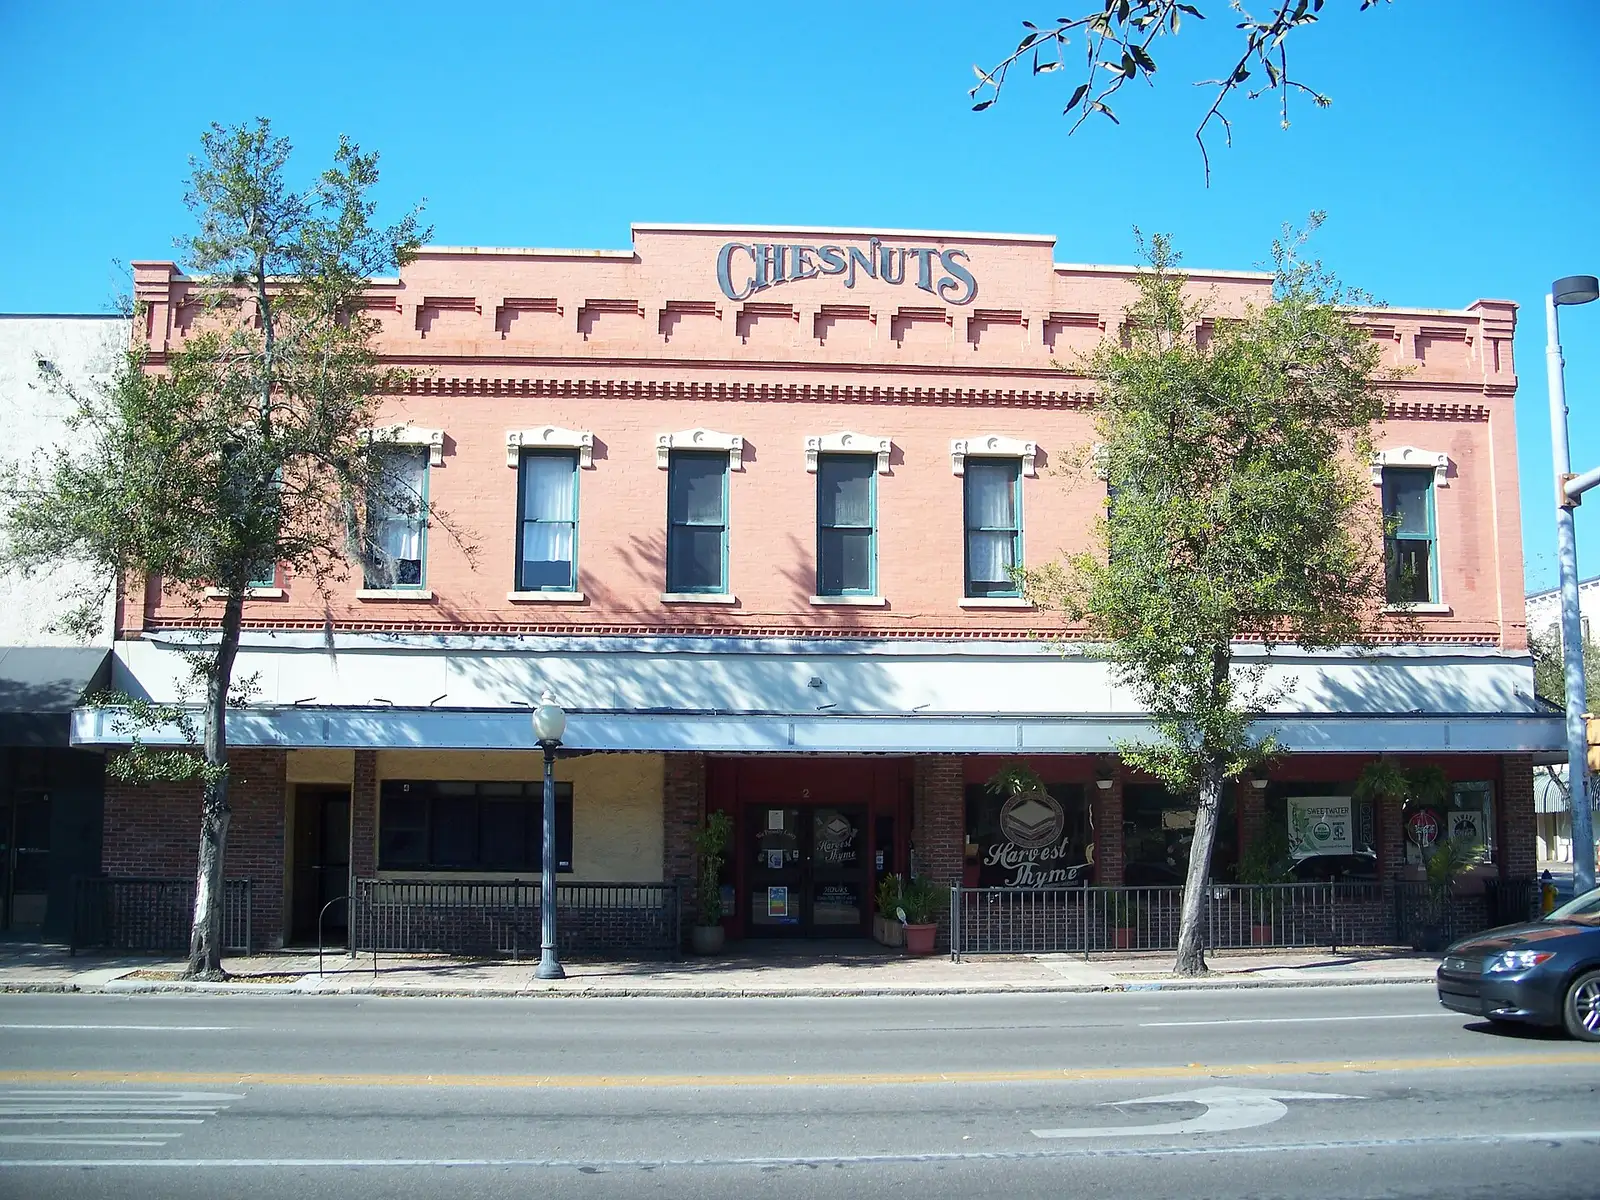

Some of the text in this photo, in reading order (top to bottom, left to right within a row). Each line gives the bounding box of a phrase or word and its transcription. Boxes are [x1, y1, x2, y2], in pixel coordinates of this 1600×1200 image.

[716, 236, 979, 306] CHESNUTS
[803, 789, 810, 798] 2
[1307, 807, 1349, 815] SWEETWATER
[816, 837, 852, 852] Harvest
[824, 848, 857, 861] Thyme
[984, 837, 1069, 870] Harvest
[1004, 863, 1082, 888] Thyme
